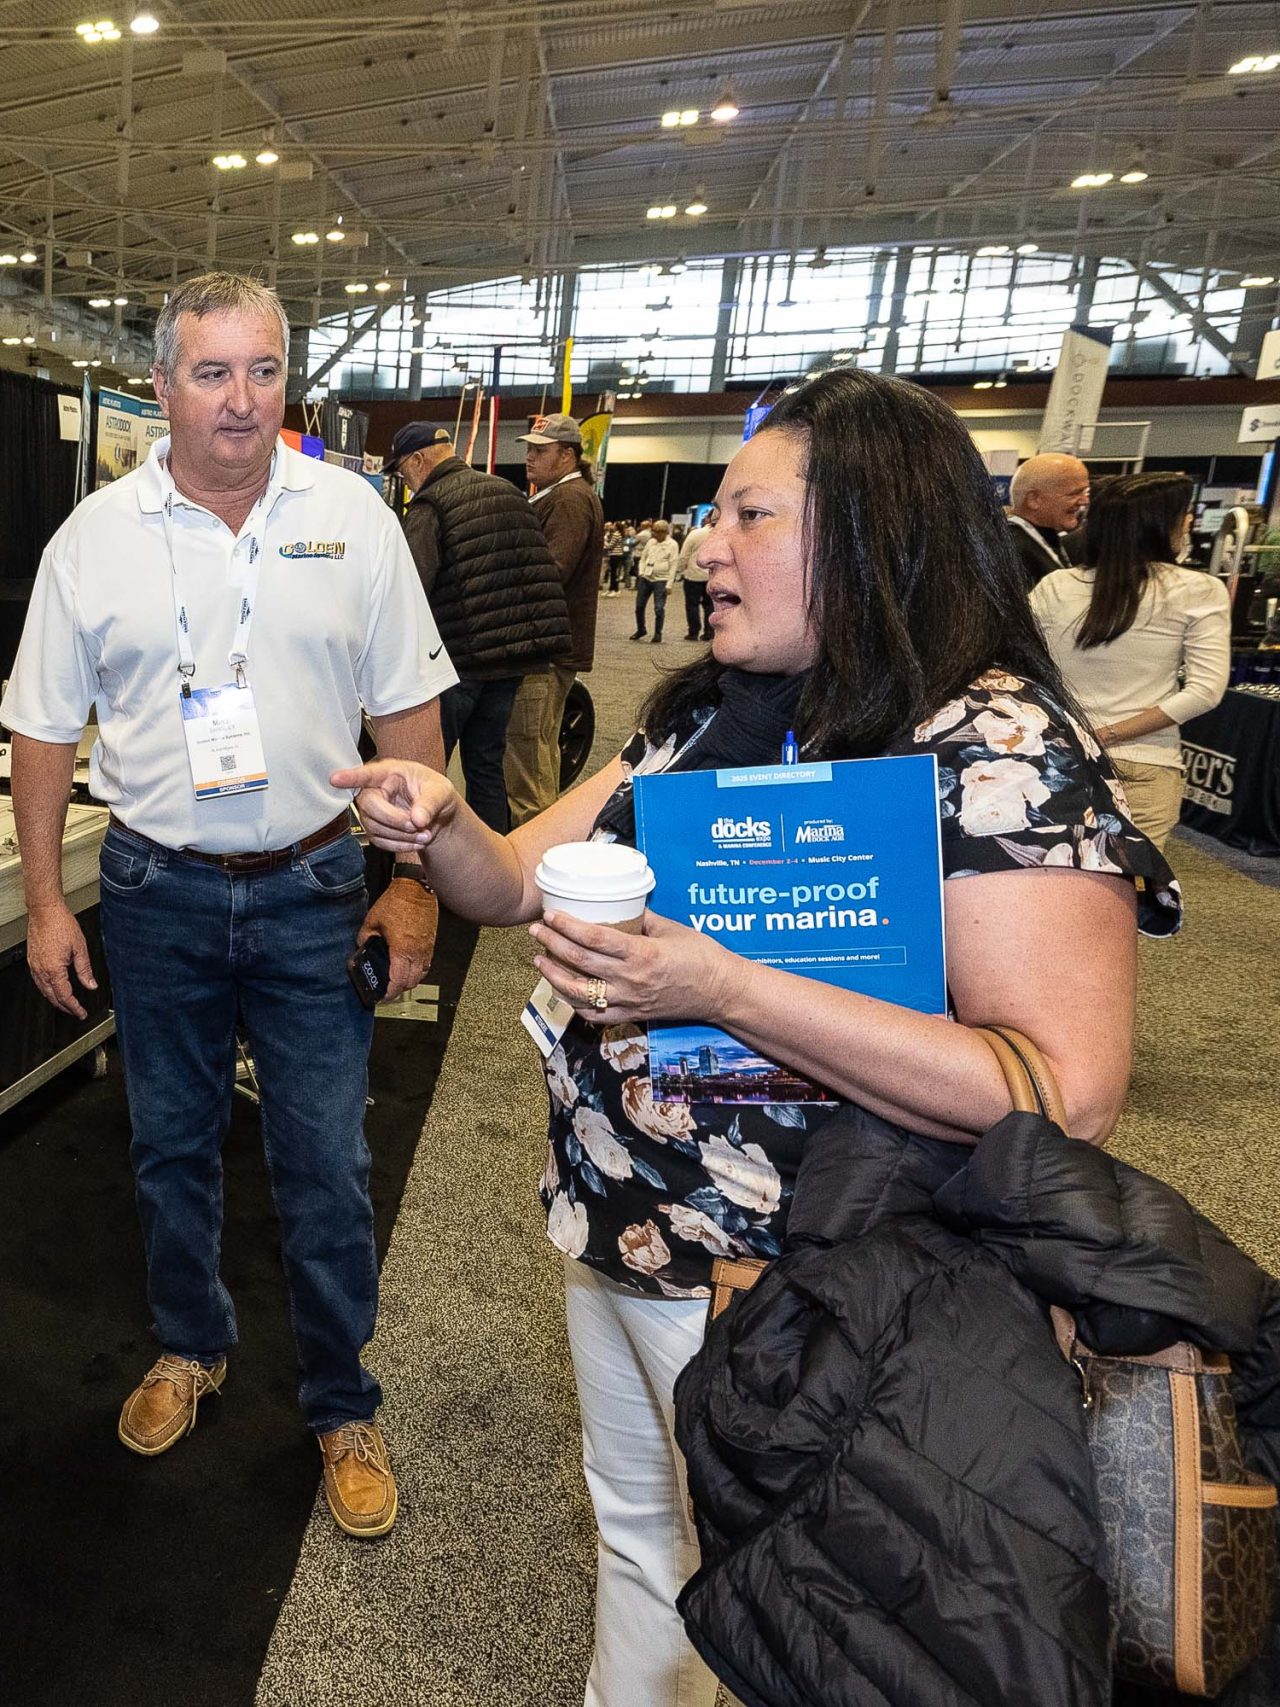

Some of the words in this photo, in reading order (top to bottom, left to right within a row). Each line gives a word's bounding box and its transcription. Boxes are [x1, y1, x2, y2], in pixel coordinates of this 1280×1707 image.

[749, 773, 773, 782] EVENT
[773, 770, 816, 780] DIRECTORY
[711, 816, 771, 839] docks
[795, 824, 844, 844] Marina
[696, 858, 729, 867] Nashville,
[730, 858, 740, 867] TN
[749, 857, 785, 866] December
[808, 855, 830, 864] Music
[831, 854, 847, 864] City
[848, 853, 874, 862] Center
[687, 876, 880, 909] future-proof
[689, 911, 757, 933] your
[765, 906, 890, 931] marina.
[785, 955, 817, 963] education
[818, 954, 845, 962] sessions
[846, 954, 860, 962] and
